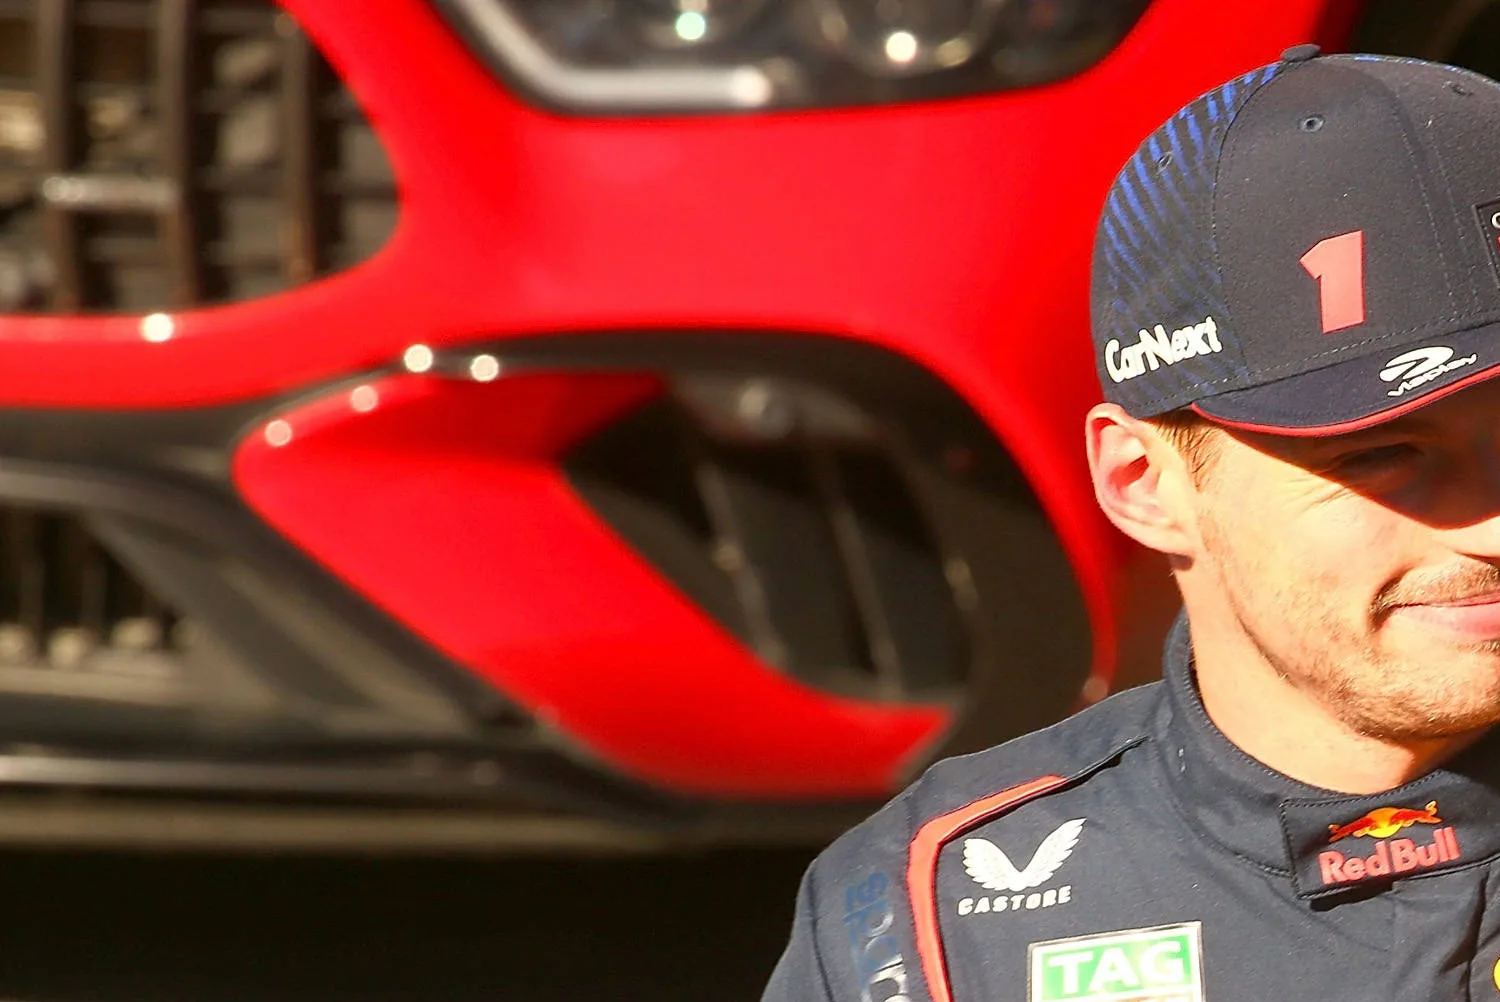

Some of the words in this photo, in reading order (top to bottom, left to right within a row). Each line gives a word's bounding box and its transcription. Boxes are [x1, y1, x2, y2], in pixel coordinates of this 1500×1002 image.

[1300, 230, 1366, 333] 1
[1105, 316, 1222, 383] CarNext
[957, 885, 1072, 916] CASTORE
[1047, 940, 1183, 996] TAG
